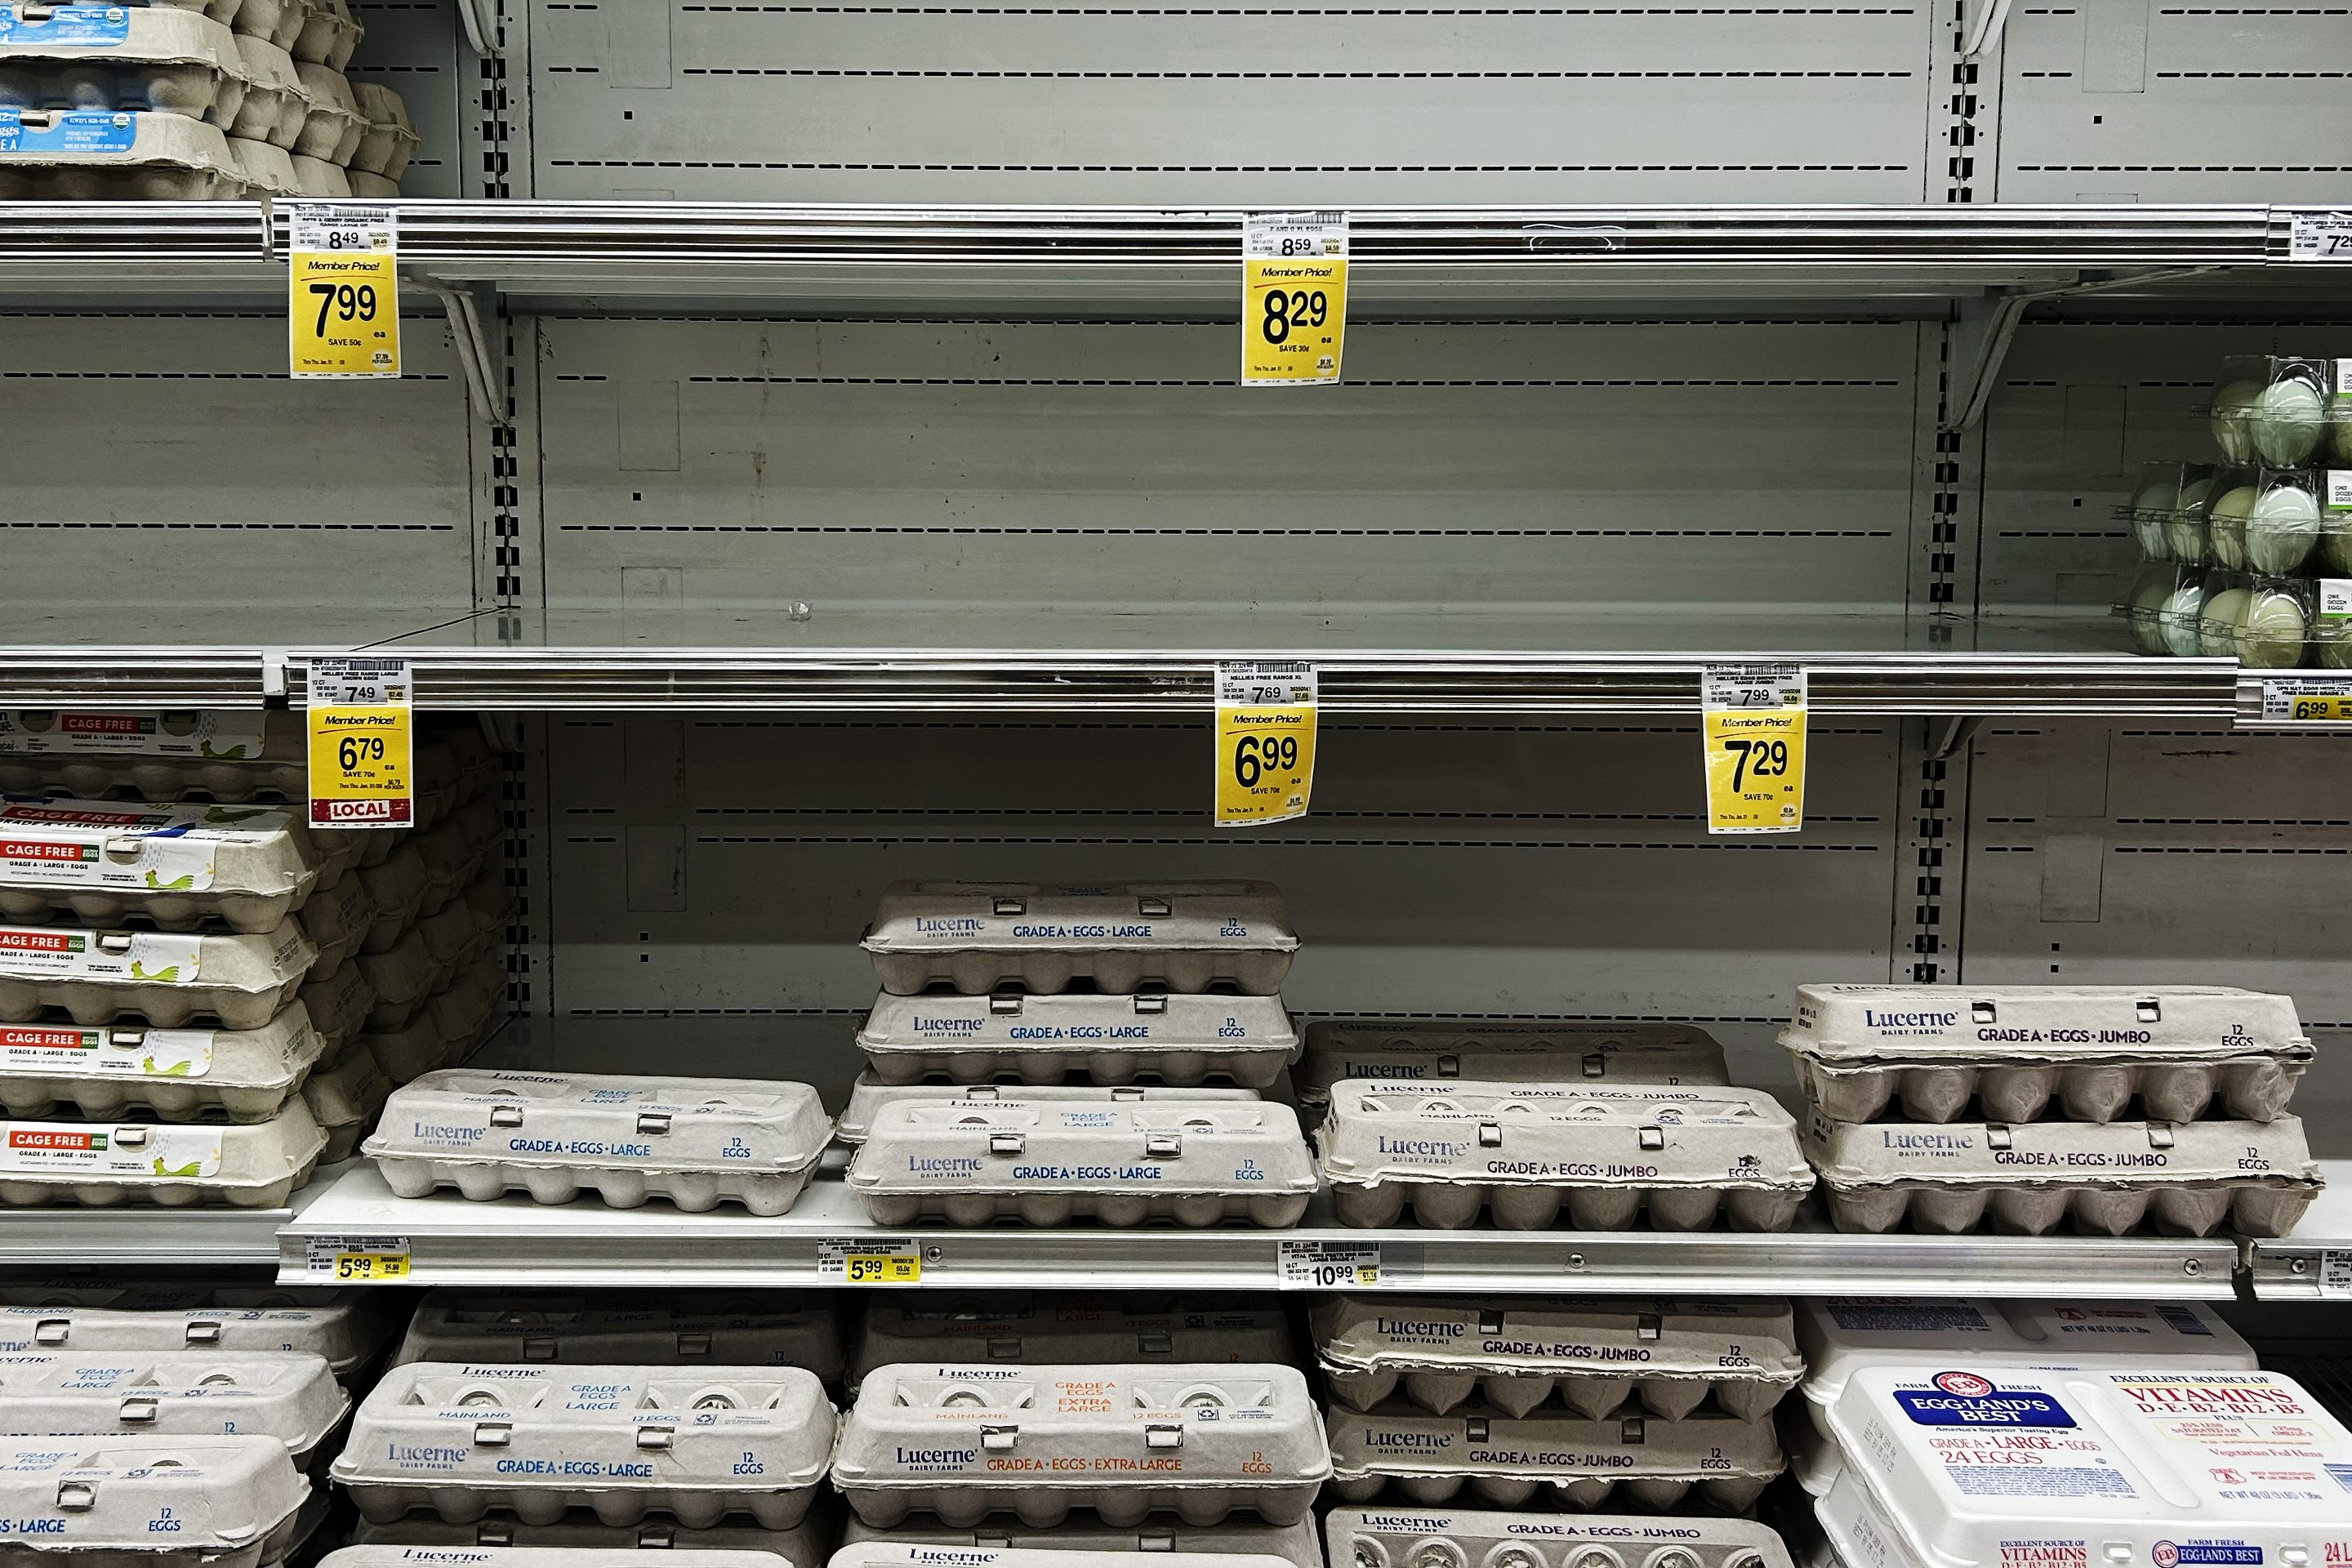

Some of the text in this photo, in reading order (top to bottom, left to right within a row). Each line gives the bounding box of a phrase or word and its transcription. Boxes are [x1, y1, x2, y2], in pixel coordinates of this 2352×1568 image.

[308, 262, 379, 270] Member Price!
[325, 716, 394, 724] Member Price!
[1234, 715, 1302, 724] Member Price!
[1722, 719, 1764, 727] Member
[333, 803, 386, 816] LOCAL
[6, 844, 74, 858] CAGE FREE
[916, 917, 985, 932] Lucerne
[1227, 917, 1238, 927] 12
[1013, 925, 1152, 938] GRADE A EGGS LARGE
[1220, 927, 1246, 937] EGGS
[914, 1017, 982, 1031] Lucerne
[1866, 1010, 1956, 1027] Lucerne
[1010, 1027, 1148, 1040] GRADE A EGGS LARGE
[1218, 1027, 1245, 1036] EGGS
[1978, 1028, 2151, 1045] GRADE A EGGS JUMBO
[7, 1033, 74, 1045] CAGE FREE
[2221, 1036, 2254, 1048] EGGS
[1345, 1062, 1424, 1078] Lucerne
[413, 1122, 483, 1141] Lucerne
[16, 1134, 84, 1147] CAGE FREE
[1379, 1135, 1467, 1156] Lucerne
[1883, 1129, 1972, 1150] Lucerne
[510, 1139, 651, 1157] GRADE A EGGS LARGE
[722, 1147, 751, 1158] EGGS
[909, 1156, 982, 1172] Lucerne
[1994, 1151, 2167, 1167] GRADE A EGGS JUMBO
[2238, 1159, 2270, 1171] EGGS
[1013, 1167, 1161, 1180] GRADE A EGGS LARGE
[1235, 1170, 1264, 1181] EGGS
[1486, 1160, 1658, 1178] GRADE A EGGS JUMBO
[1377, 1316, 1464, 1336] Lucerne
[1483, 1340, 1651, 1362] GRADE A EGGS JUMBO
[1730, 1345, 1741, 1356] 12
[1718, 1356, 1750, 1367] EGGS
[2109, 1375, 2189, 1383] EXCELLENT
[2119, 1388, 2294, 1403] VITAMINS
[1960, 1410, 2022, 1422] BEST
[1365, 1429, 1452, 1447] Lucerne
[1930, 1437, 2101, 1451] GRADE A LARGE EGGS
[389, 1443, 466, 1462] Lucerne
[742, 1451, 753, 1463] 12
[897, 1447, 974, 1464] Lucerne
[1252, 1451, 1263, 1462] 12
[1470, 1450, 1633, 1468] GRADE A EGGS JUMBO
[1940, 1451, 2042, 1464] 24 EGGS
[497, 1459, 653, 1477] GRADE A EGGS LARGE
[733, 1463, 764, 1475] EGGS
[987, 1459, 1183, 1471] GRADE A EGGS EXTRA LARGE
[1241, 1463, 1272, 1474] EGGS
[1700, 1459, 1731, 1470] EGGS
[161, 1508, 171, 1519] 12
[20, 1519, 65, 1533] LARGE
[149, 1521, 181, 1531] EGGS
[1361, 1513, 1449, 1528] Lucerne
[909, 1548, 996, 1563] Lucerne
[2000, 1548, 2087, 1561] VITAMINS
[2325, 1543, 2340, 1559] 24
